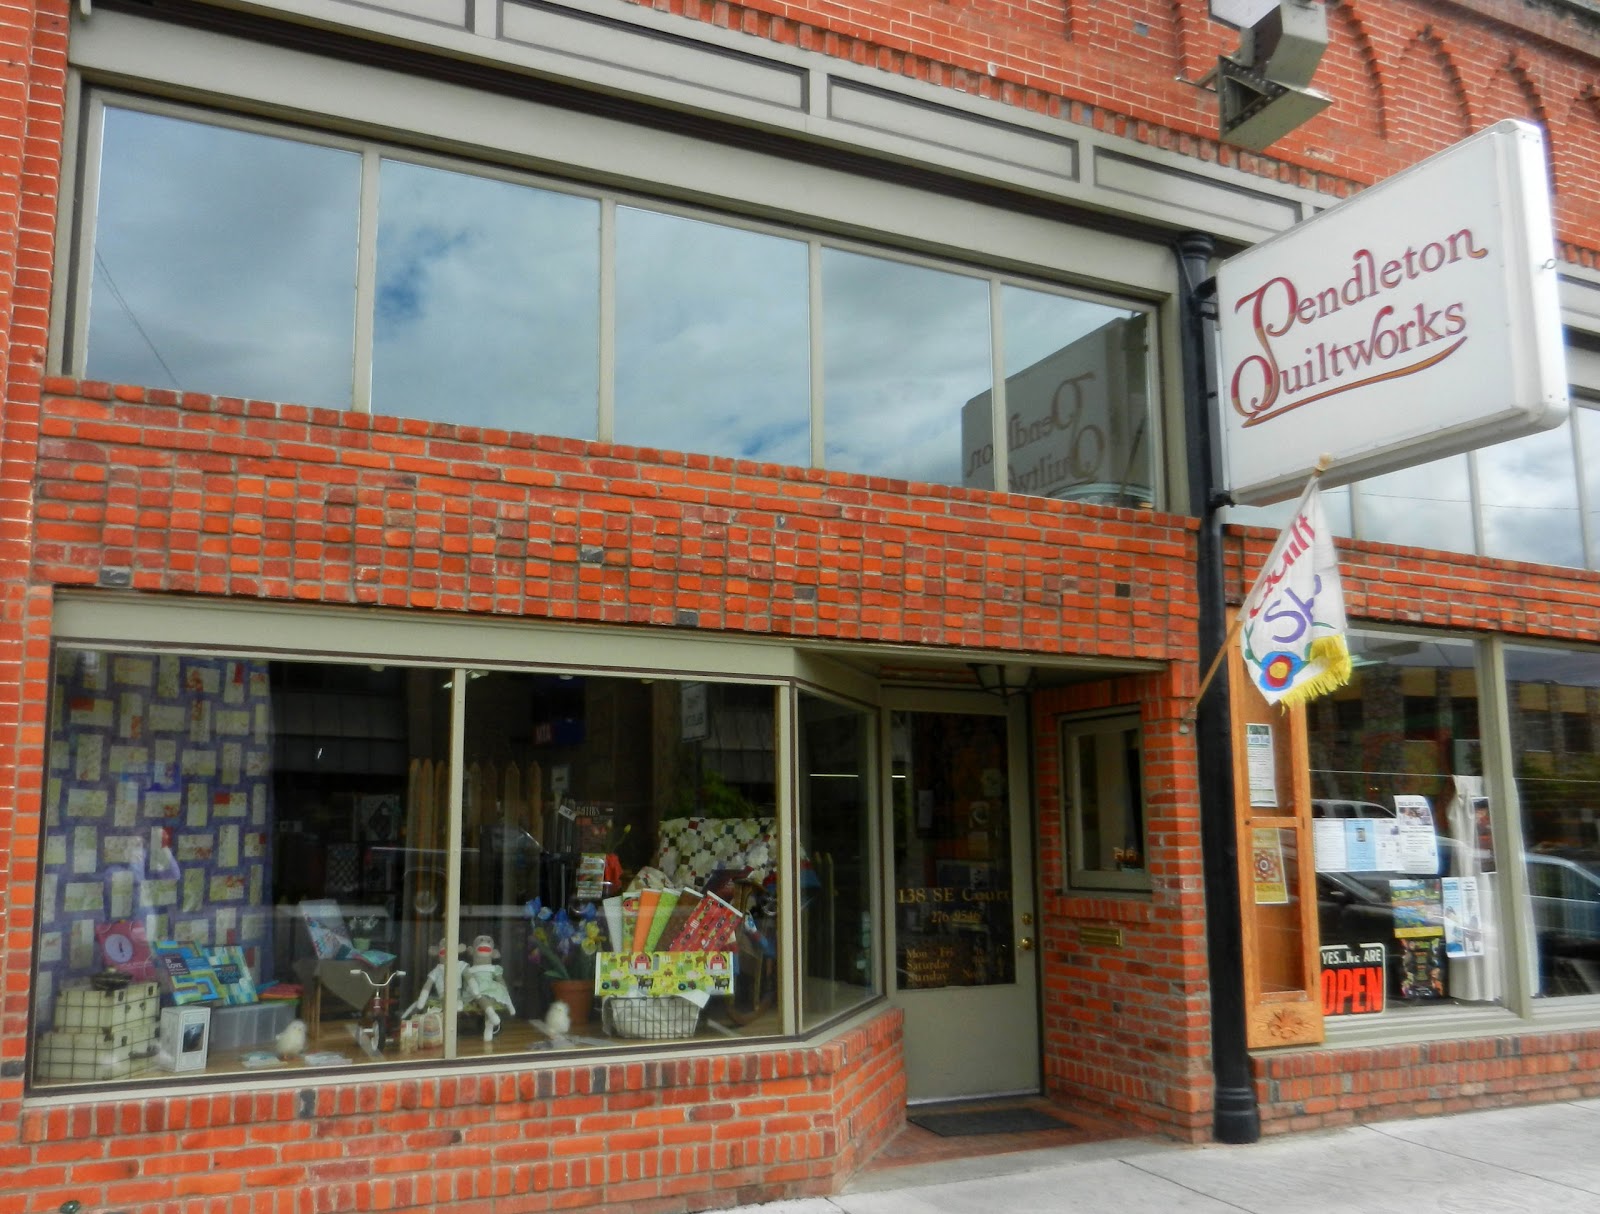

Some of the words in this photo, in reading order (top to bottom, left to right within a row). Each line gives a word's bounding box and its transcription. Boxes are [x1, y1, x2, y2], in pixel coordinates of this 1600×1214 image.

[1234, 228, 1489, 338] Pendleton
[1231, 302, 1468, 418] Quiltworks
[898, 888, 925, 903] 138
[933, 888, 954, 902] SE
[907, 960, 950, 970] Saturday
[1363, 949, 1382, 963] ARE
[1320, 966, 1383, 1016] OPEN
